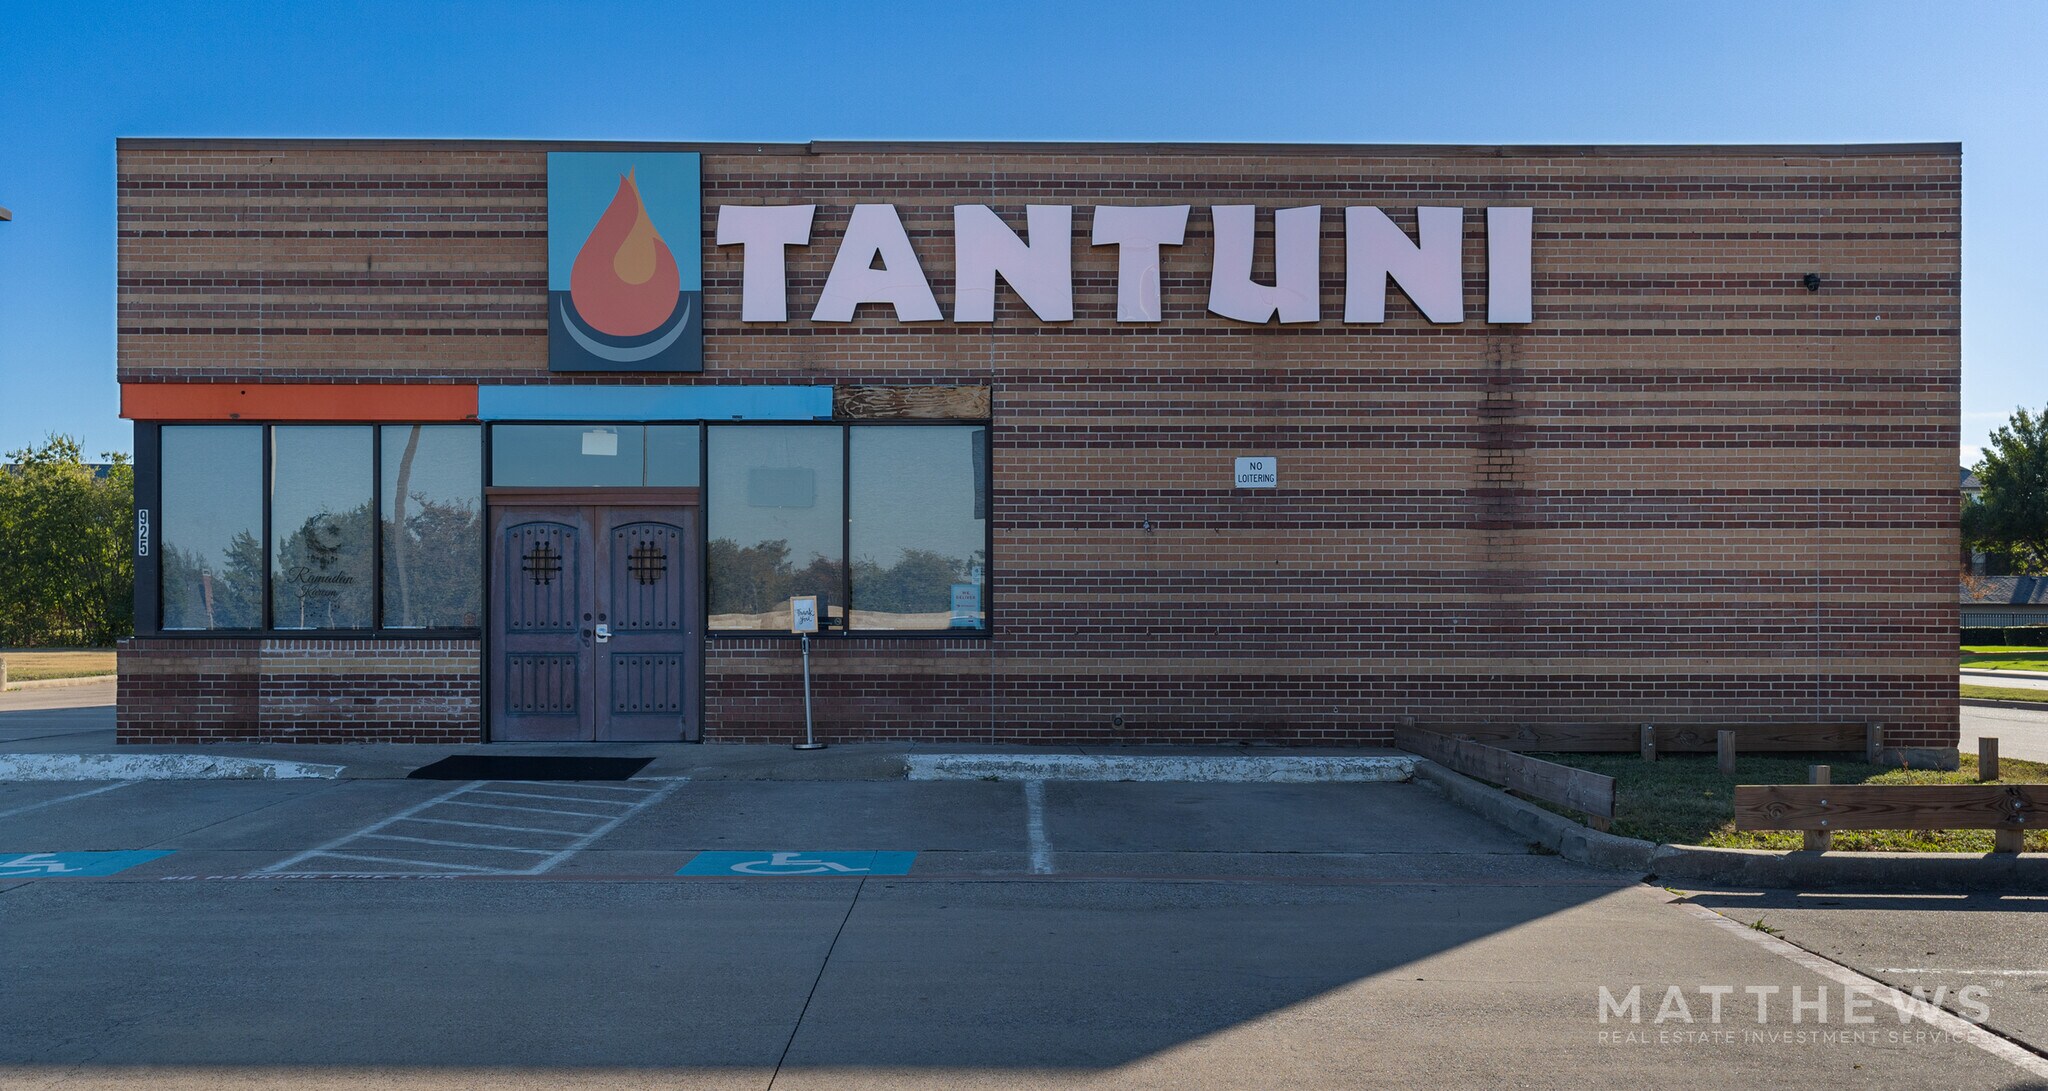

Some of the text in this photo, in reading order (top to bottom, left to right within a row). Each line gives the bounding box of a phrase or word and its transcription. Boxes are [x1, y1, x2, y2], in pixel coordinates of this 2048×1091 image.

[716, 202, 1534, 325] TANTUNI
[1249, 461, 1263, 471] NO
[1237, 473, 1275, 483] LOITERING
[139, 510, 148, 555] 925
[287, 566, 354, 584] Ramadan
